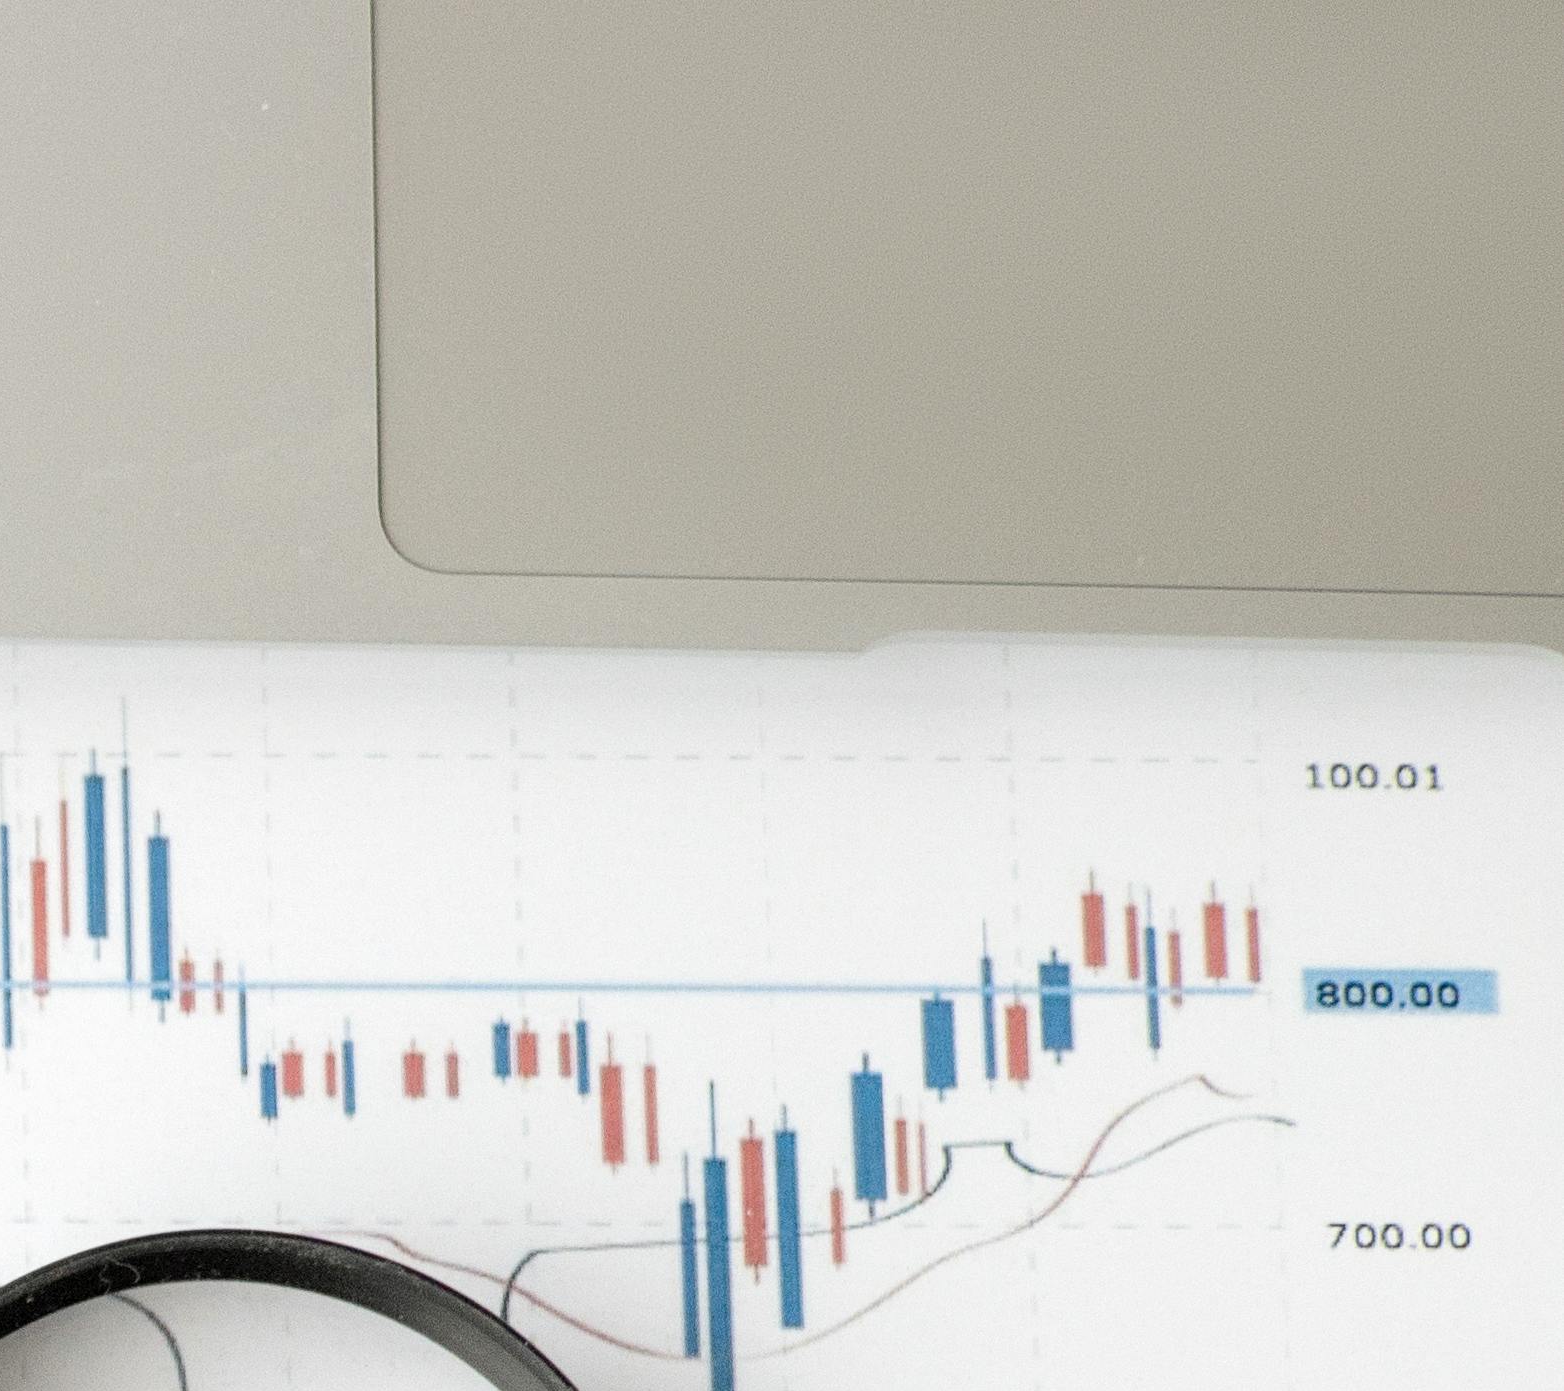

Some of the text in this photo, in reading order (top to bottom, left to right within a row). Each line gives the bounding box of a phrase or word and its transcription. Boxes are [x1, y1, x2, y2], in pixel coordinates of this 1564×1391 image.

[1307, 763, 1439, 790] 100.01
[1314, 980, 1460, 1010] 800.00
[1329, 1222, 1472, 1250] 700.00
